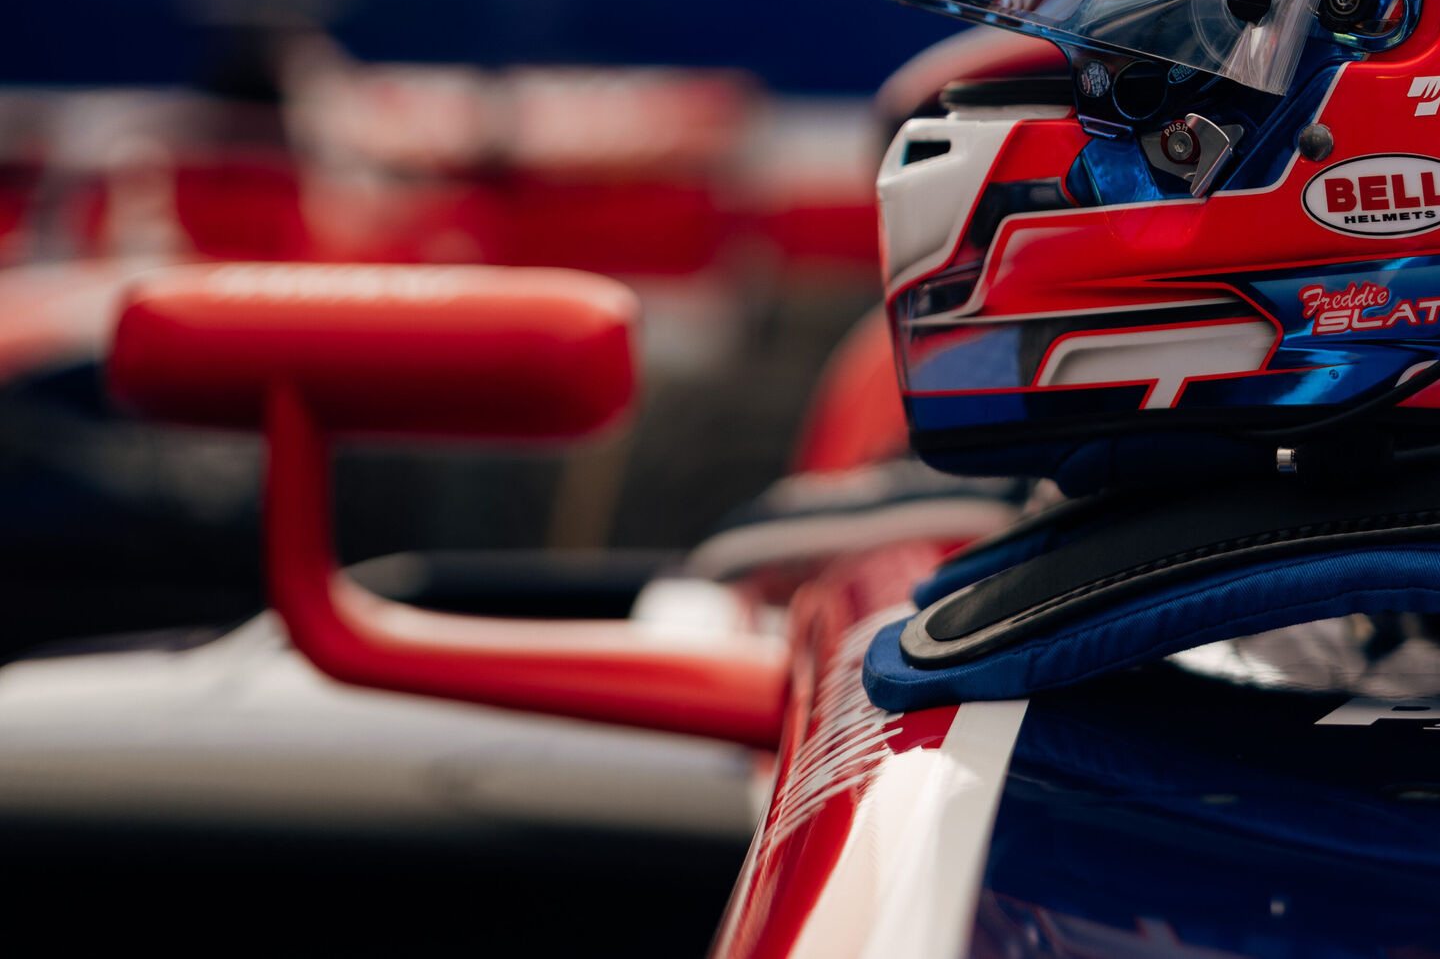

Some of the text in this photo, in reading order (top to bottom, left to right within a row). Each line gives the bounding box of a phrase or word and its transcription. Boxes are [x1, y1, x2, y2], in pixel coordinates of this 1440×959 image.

[1163, 121, 1188, 136] PUSH
[1344, 210, 1437, 224] HELMETS
[1302, 284, 1388, 316] Freddie
